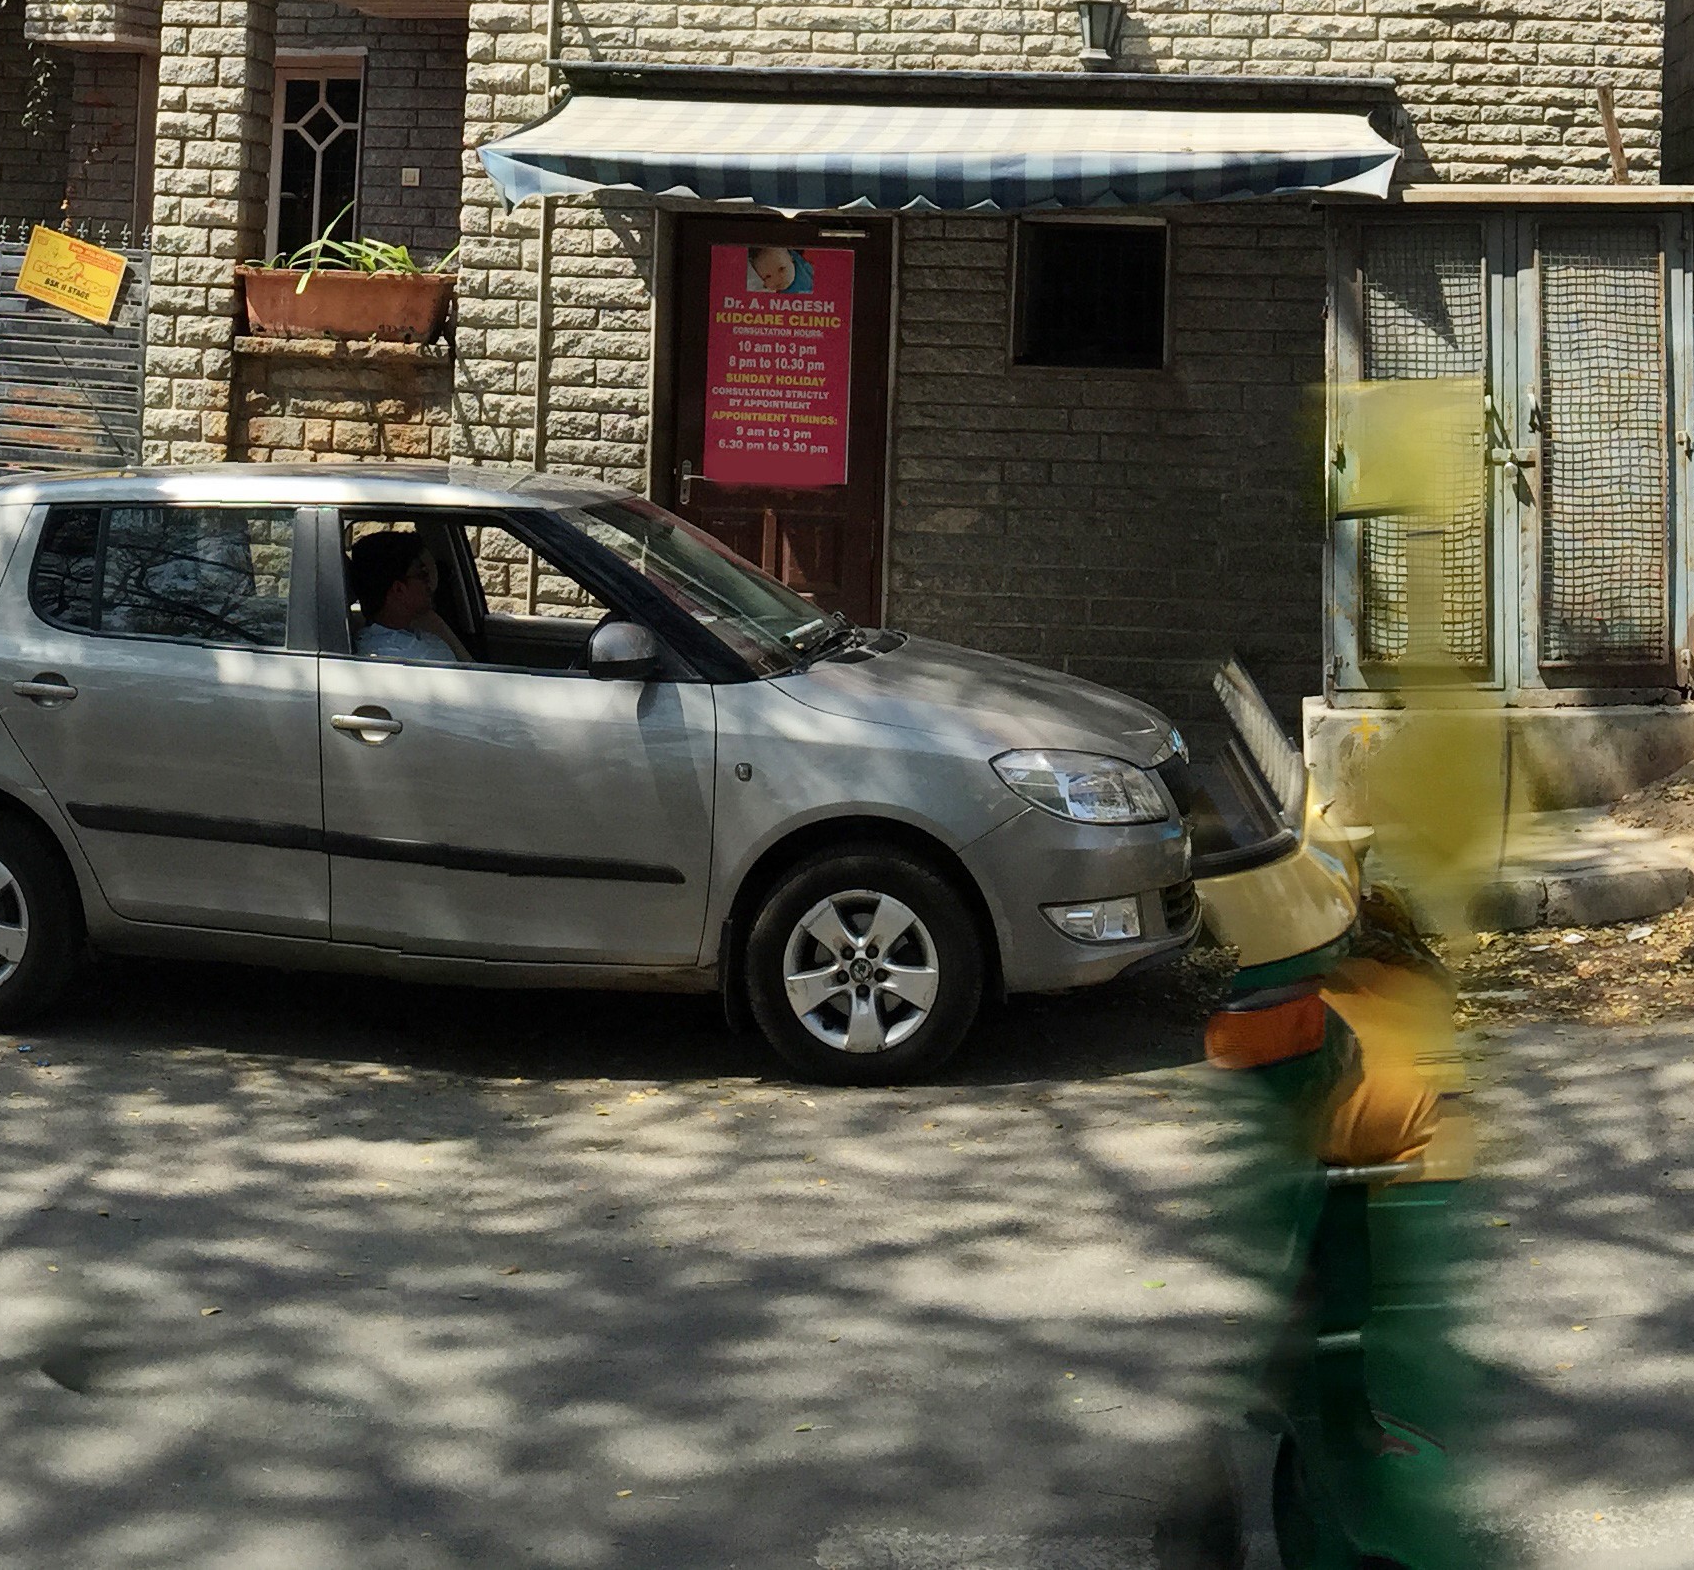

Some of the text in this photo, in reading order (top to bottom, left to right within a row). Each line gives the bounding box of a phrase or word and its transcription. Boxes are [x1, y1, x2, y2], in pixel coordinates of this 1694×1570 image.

[723, 296, 835, 313] Dr. A. NAGESH
[716, 311, 841, 328] KIDCARE CLINIC
[732, 326, 792, 337] CONSULTATION
[738, 340, 817, 357] 10 am to 3 pm
[729, 355, 825, 372] 8 pm to 10.30 pm
[726, 373, 826, 387] SUNDAY HOLIDAY
[712, 386, 829, 400] CONSULTATION STRICTLY
[729, 398, 811, 410] BY APPOINTMENT
[712, 410, 838, 425] APPOINTMENT TIMINGS:
[746, 428, 765, 437] am
[768, 427, 780, 438] to
[793, 430, 811, 440] pm
[718, 439, 828, 455] 6.30 pm to 9.30 pm
